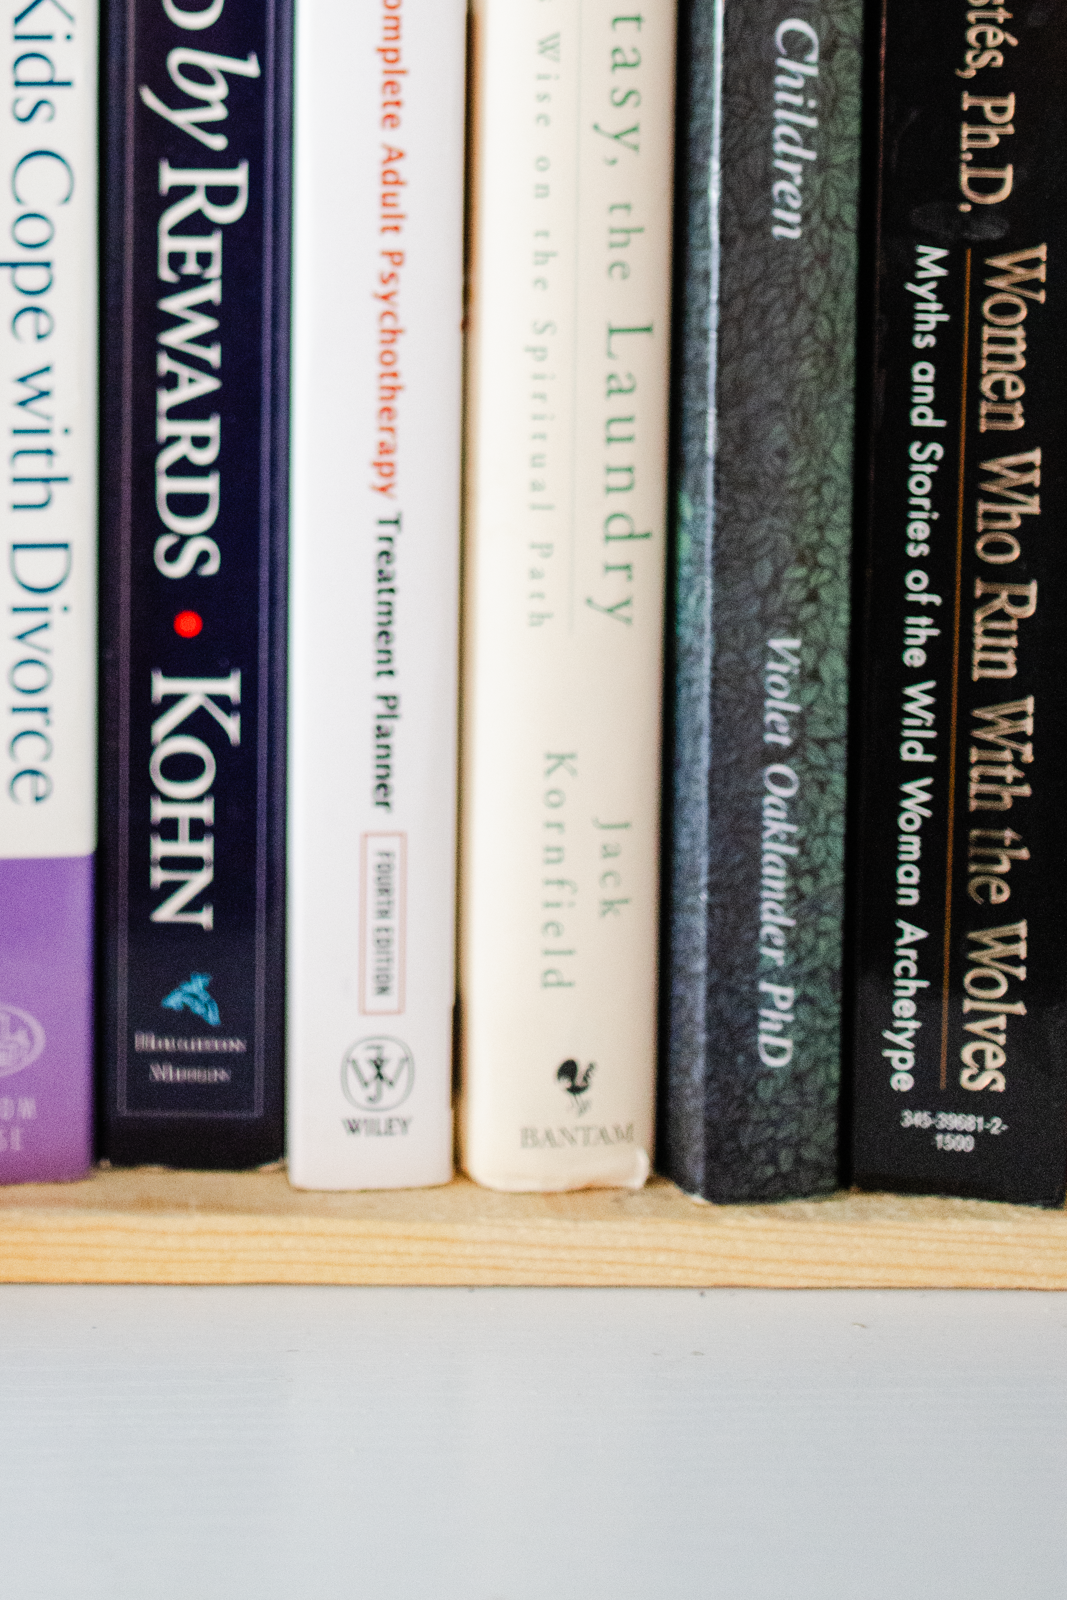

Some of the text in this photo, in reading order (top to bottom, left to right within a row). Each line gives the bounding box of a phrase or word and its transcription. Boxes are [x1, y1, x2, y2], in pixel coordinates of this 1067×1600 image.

[139, 47, 261, 151] by
[535, 32, 560, 127] Wise
[771, 18, 819, 240] Children
[958, 90, 1015, 213] Ph.D.
[380, 144, 407, 235] Adult
[534, 156, 550, 199] on
[607, 203, 645, 280] the
[533, 229, 558, 291] the
[11, 365, 71, 511] with
[153, 158, 249, 580] REWARDS
[370, 251, 405, 499] Psychotherapy
[523, 320, 557, 510] Spiritual
[586, 321, 654, 626] Laundry
[376, 512, 401, 678] Treatment
[528, 543, 554, 627] Path
[9, 542, 72, 805] Divorce
[882, 244, 950, 1092] Myths and Stories of the Wild Woman Archetype
[959, 242, 1047, 1092] Women Who Run With the Wolves
[149, 667, 241, 932] KOHN
[375, 695, 400, 812] Planner
[373, 851, 395, 996] FOURTH EDITION
[540, 751, 578, 989] Kornfield
[592, 815, 631, 918] Jack
[758, 638, 801, 1068] Violet Oaklander PhD
[342, 1116, 412, 1137] WILEY
[520, 1123, 634, 1149] BANTAM
